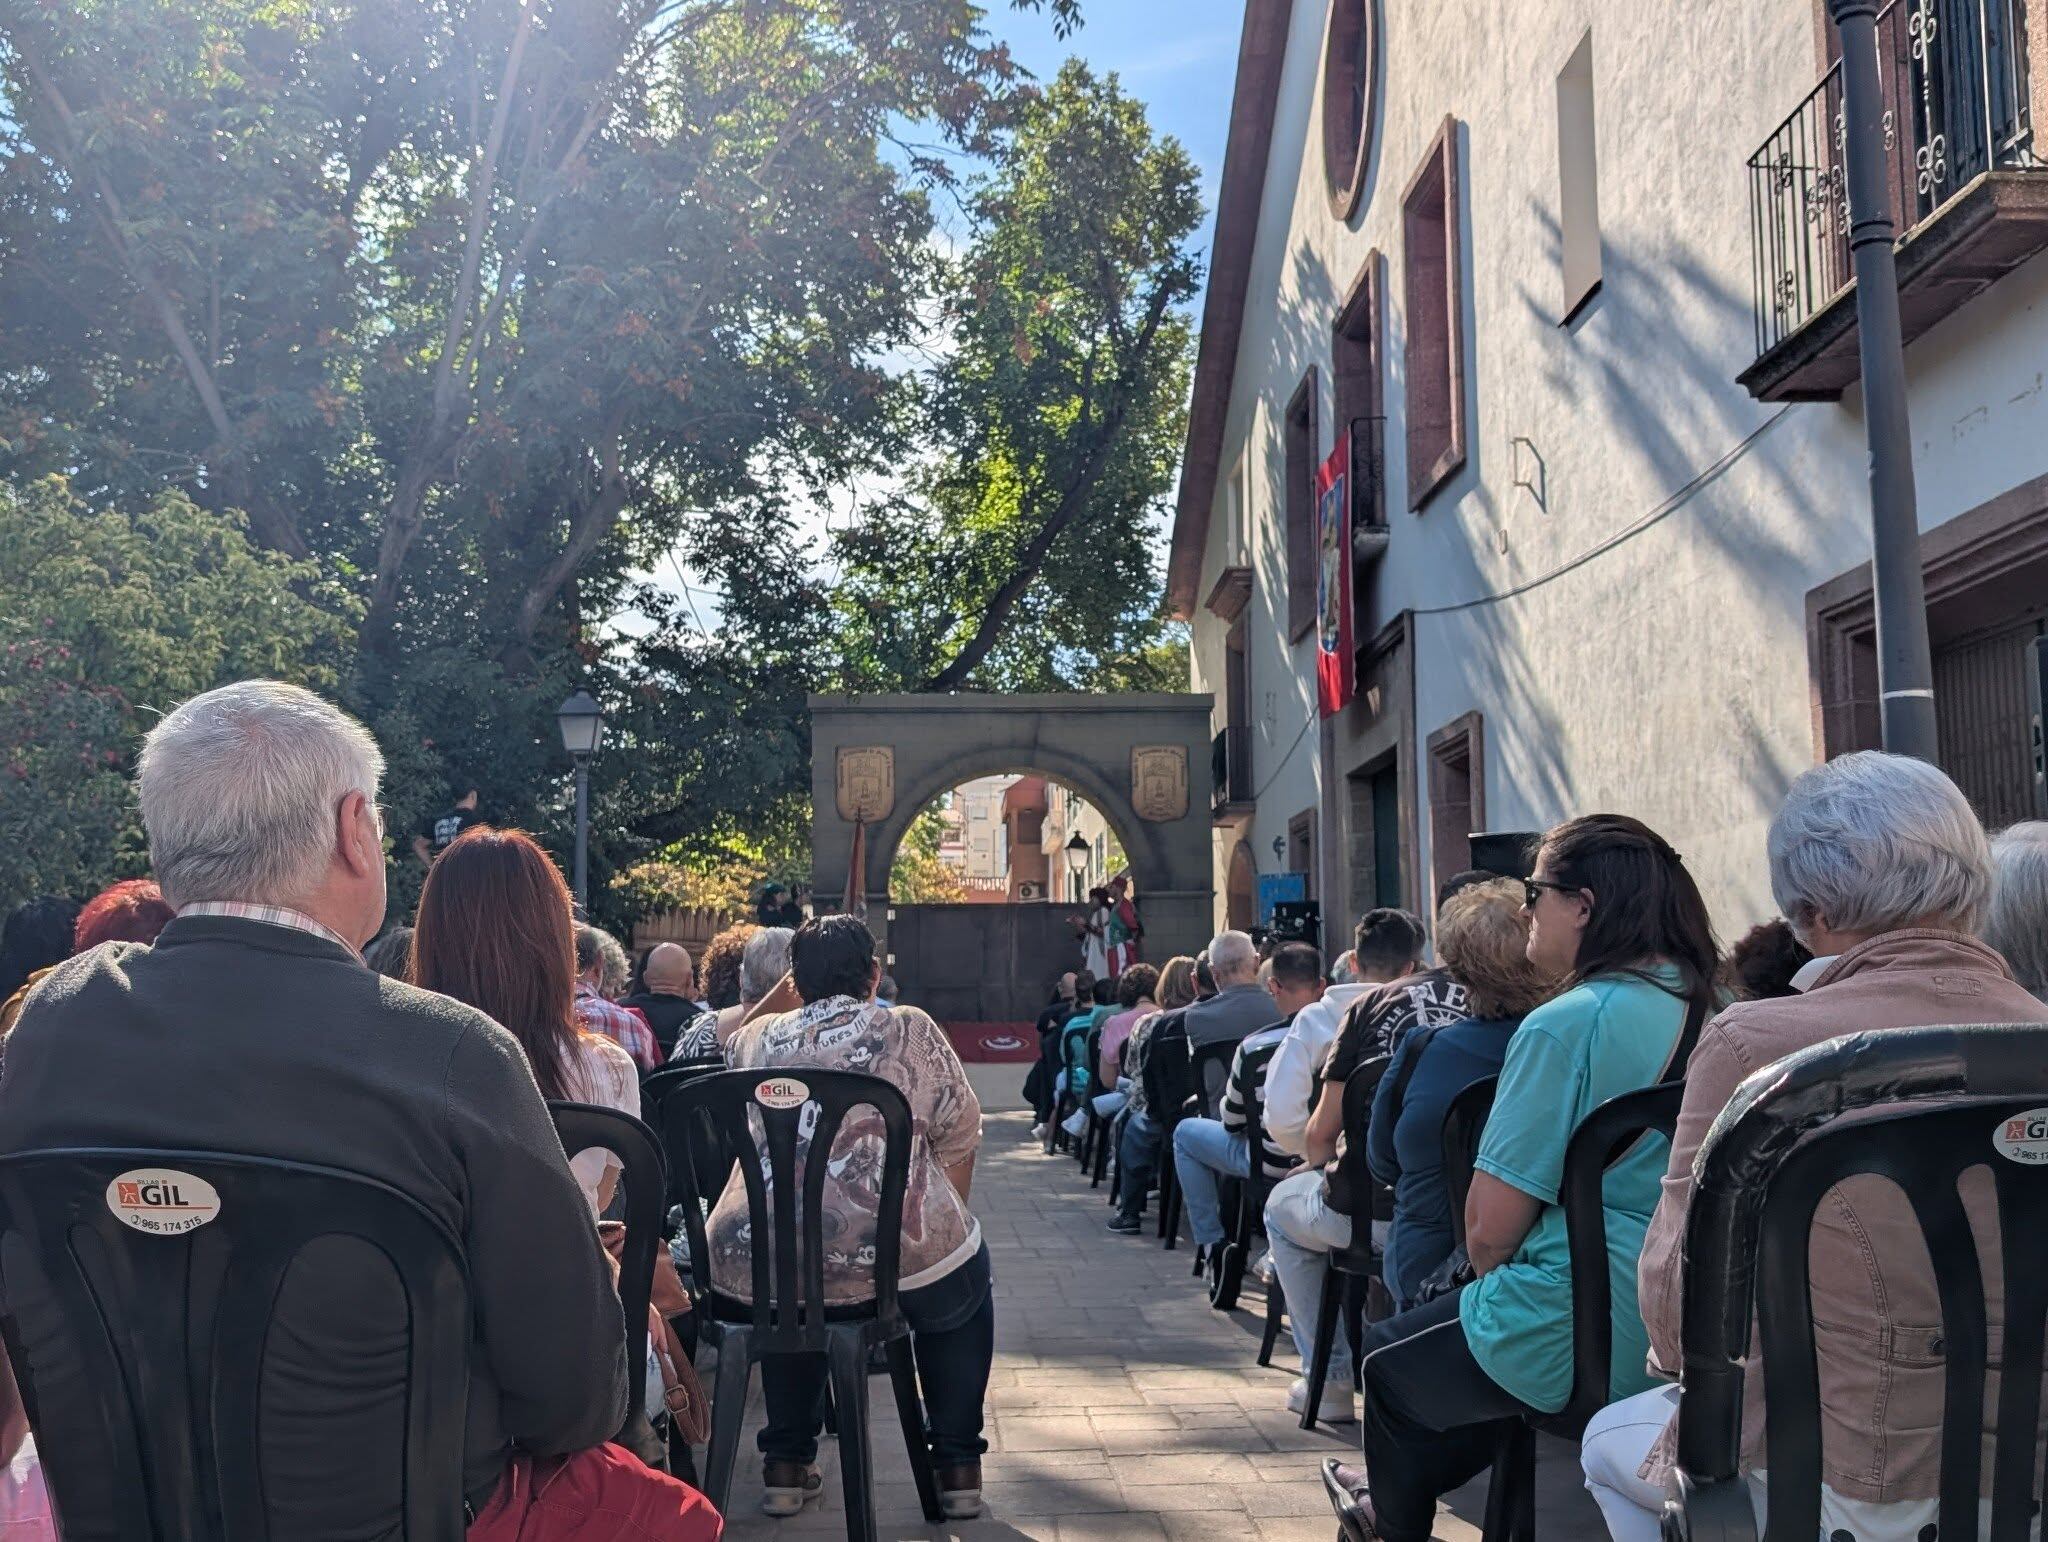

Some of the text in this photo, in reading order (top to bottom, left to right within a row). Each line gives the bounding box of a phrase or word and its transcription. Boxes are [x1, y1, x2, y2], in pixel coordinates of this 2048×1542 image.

[773, 1083, 794, 1095] GIL
[141, 1180, 189, 1205] GIL
[142, 1216, 202, 1231] 965 174 315
